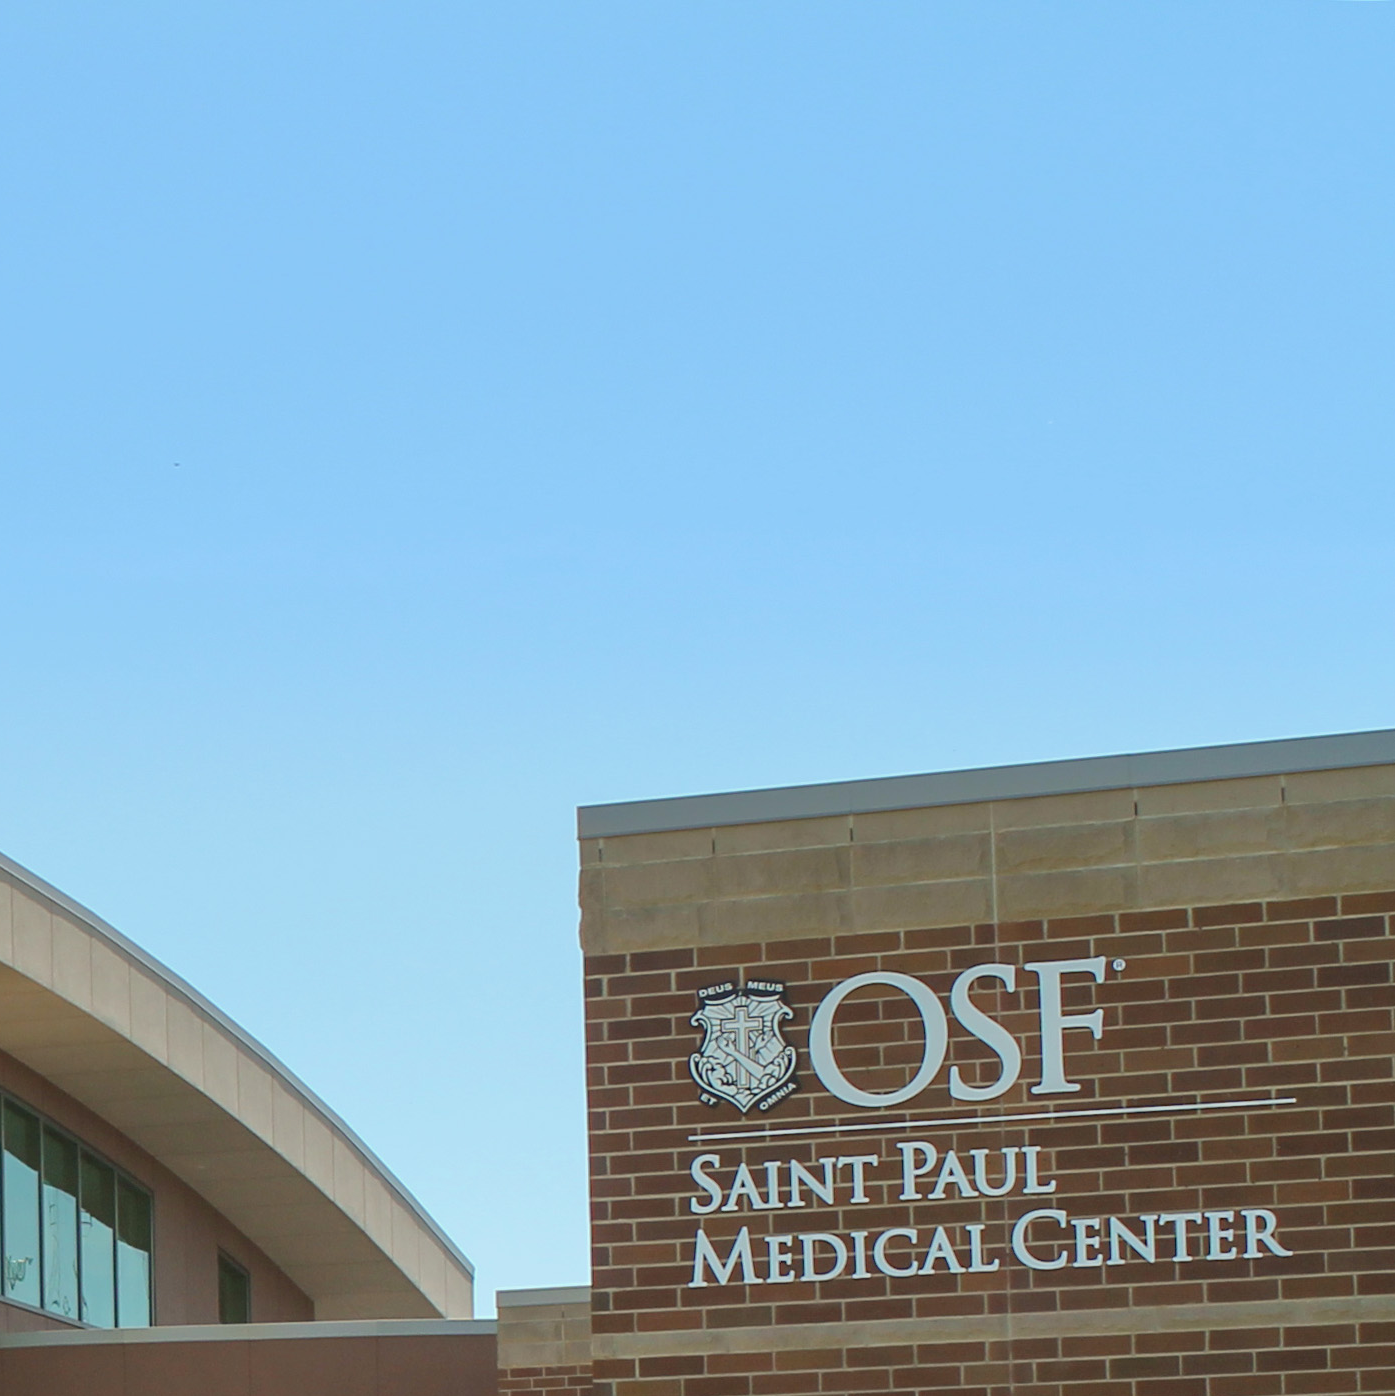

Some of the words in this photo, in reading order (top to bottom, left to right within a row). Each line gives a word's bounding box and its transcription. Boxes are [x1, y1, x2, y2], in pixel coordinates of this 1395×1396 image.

[698, 982, 734, 998] DEUS
[747, 981, 784, 992] MEUS
[809, 955, 1106, 1109] OSF
[700, 1093, 718, 1106] ET
[759, 1082, 797, 1111] OMNIA
[689, 1153, 878, 1216] SAINT
[897, 1141, 1057, 1202] PAUL
[688, 1224, 999, 1289] MEDICAL
[1011, 1208, 1294, 1272] CENTER
